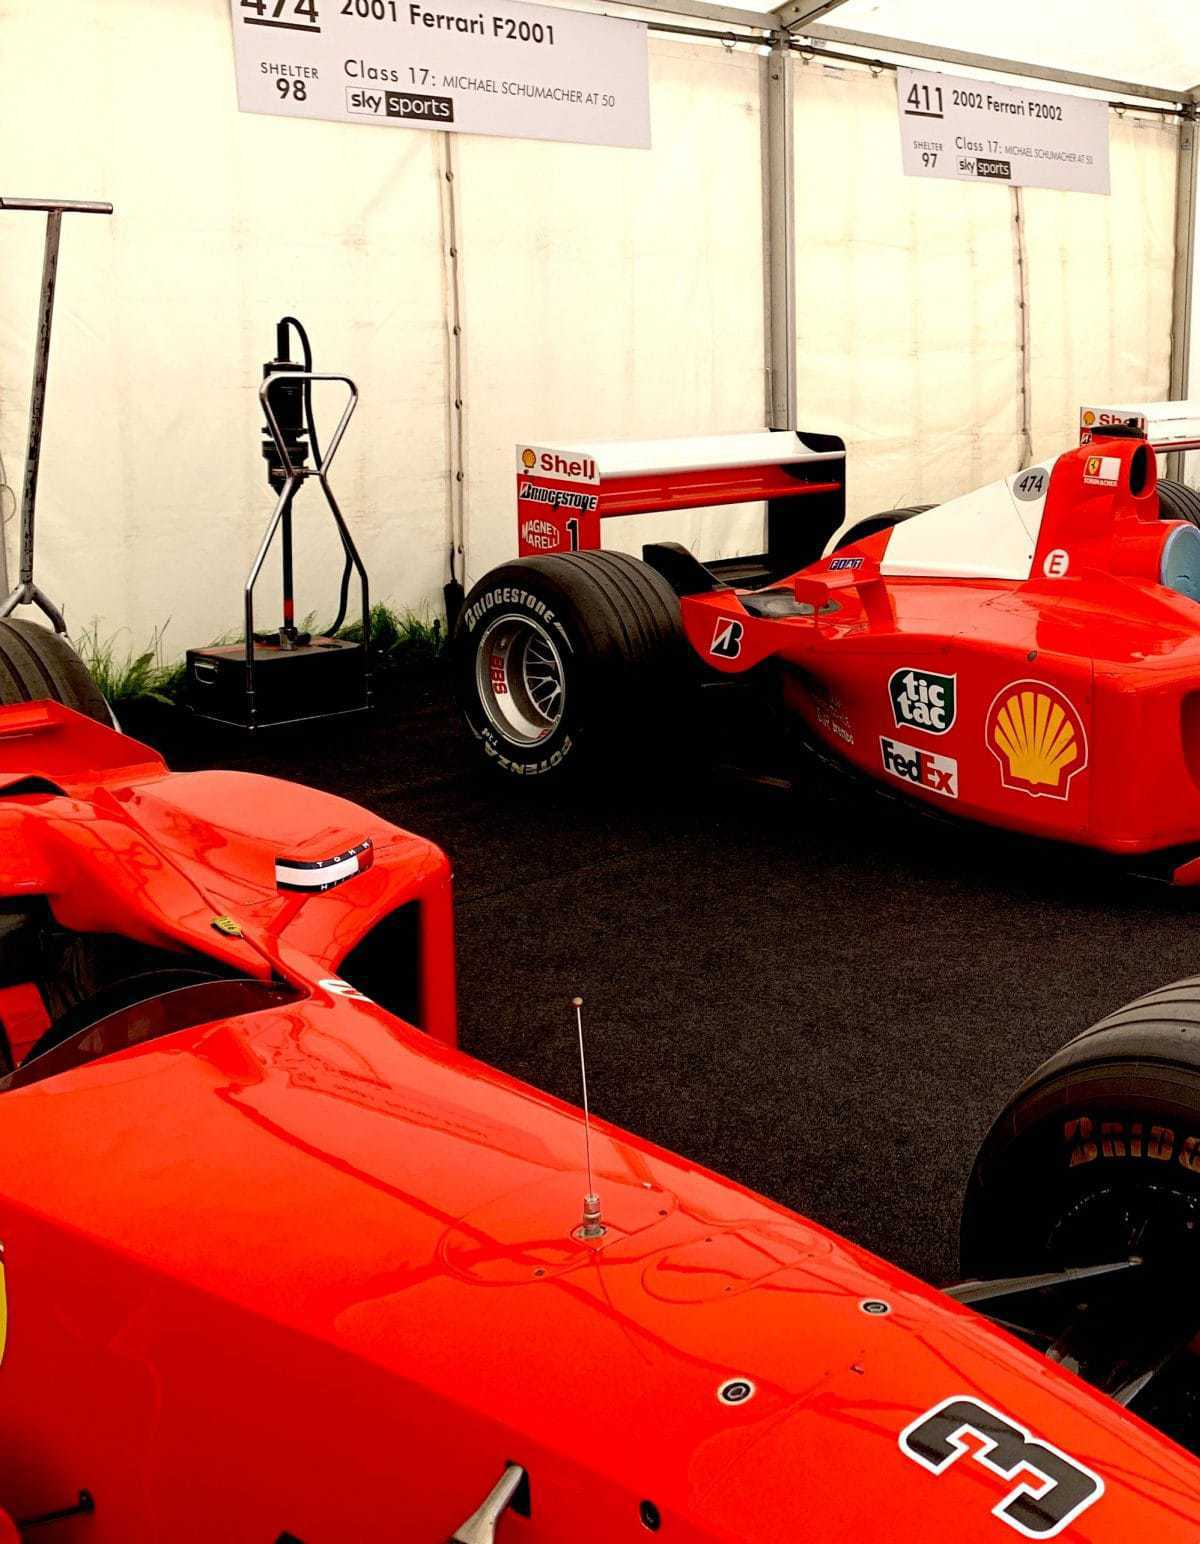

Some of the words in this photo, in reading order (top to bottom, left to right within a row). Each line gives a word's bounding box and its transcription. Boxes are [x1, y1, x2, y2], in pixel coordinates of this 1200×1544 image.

[340, 0, 397, 22] 2001
[409, 4, 485, 36] Ferrari
[493, 19, 556, 46] F2001
[260, 61, 319, 80] SHELTER
[344, 59, 399, 83] Class
[407, 67, 437, 87] 17:
[443, 75, 498, 95] MICHAEL
[501, 79, 583, 104] SCHUMACHER
[585, 92, 600, 106] AT
[602, 94, 616, 108] 50
[275, 78, 308, 102] 98
[350, 90, 384, 113] sky
[388, 95, 450, 118] sports
[906, 83, 944, 112] 411
[952, 89, 984, 109] 2002
[987, 96, 1025, 116] Ferrari
[1028, 101, 1063, 121] F2002
[955, 136, 984, 152] Class
[921, 152, 938, 168] 97
[959, 156, 976, 175] sky
[976, 159, 1010, 178] sports
[1099, 413, 1145, 431] Shl
[541, 452, 595, 480] Shell
[519, 482, 599, 511] BRIDGESTONE
[1019, 474, 1043, 493] 474
[566, 517, 580, 552] 1
[829, 559, 864, 570] FIAT
[1048, 553, 1065, 575] E
[464, 587, 555, 633] BRIDGESTONE
[902, 671, 946, 708] tic
[897, 691, 946, 730] tac
[880, 738, 955, 798] FedEx
[899, 1394, 1105, 1539] 3
